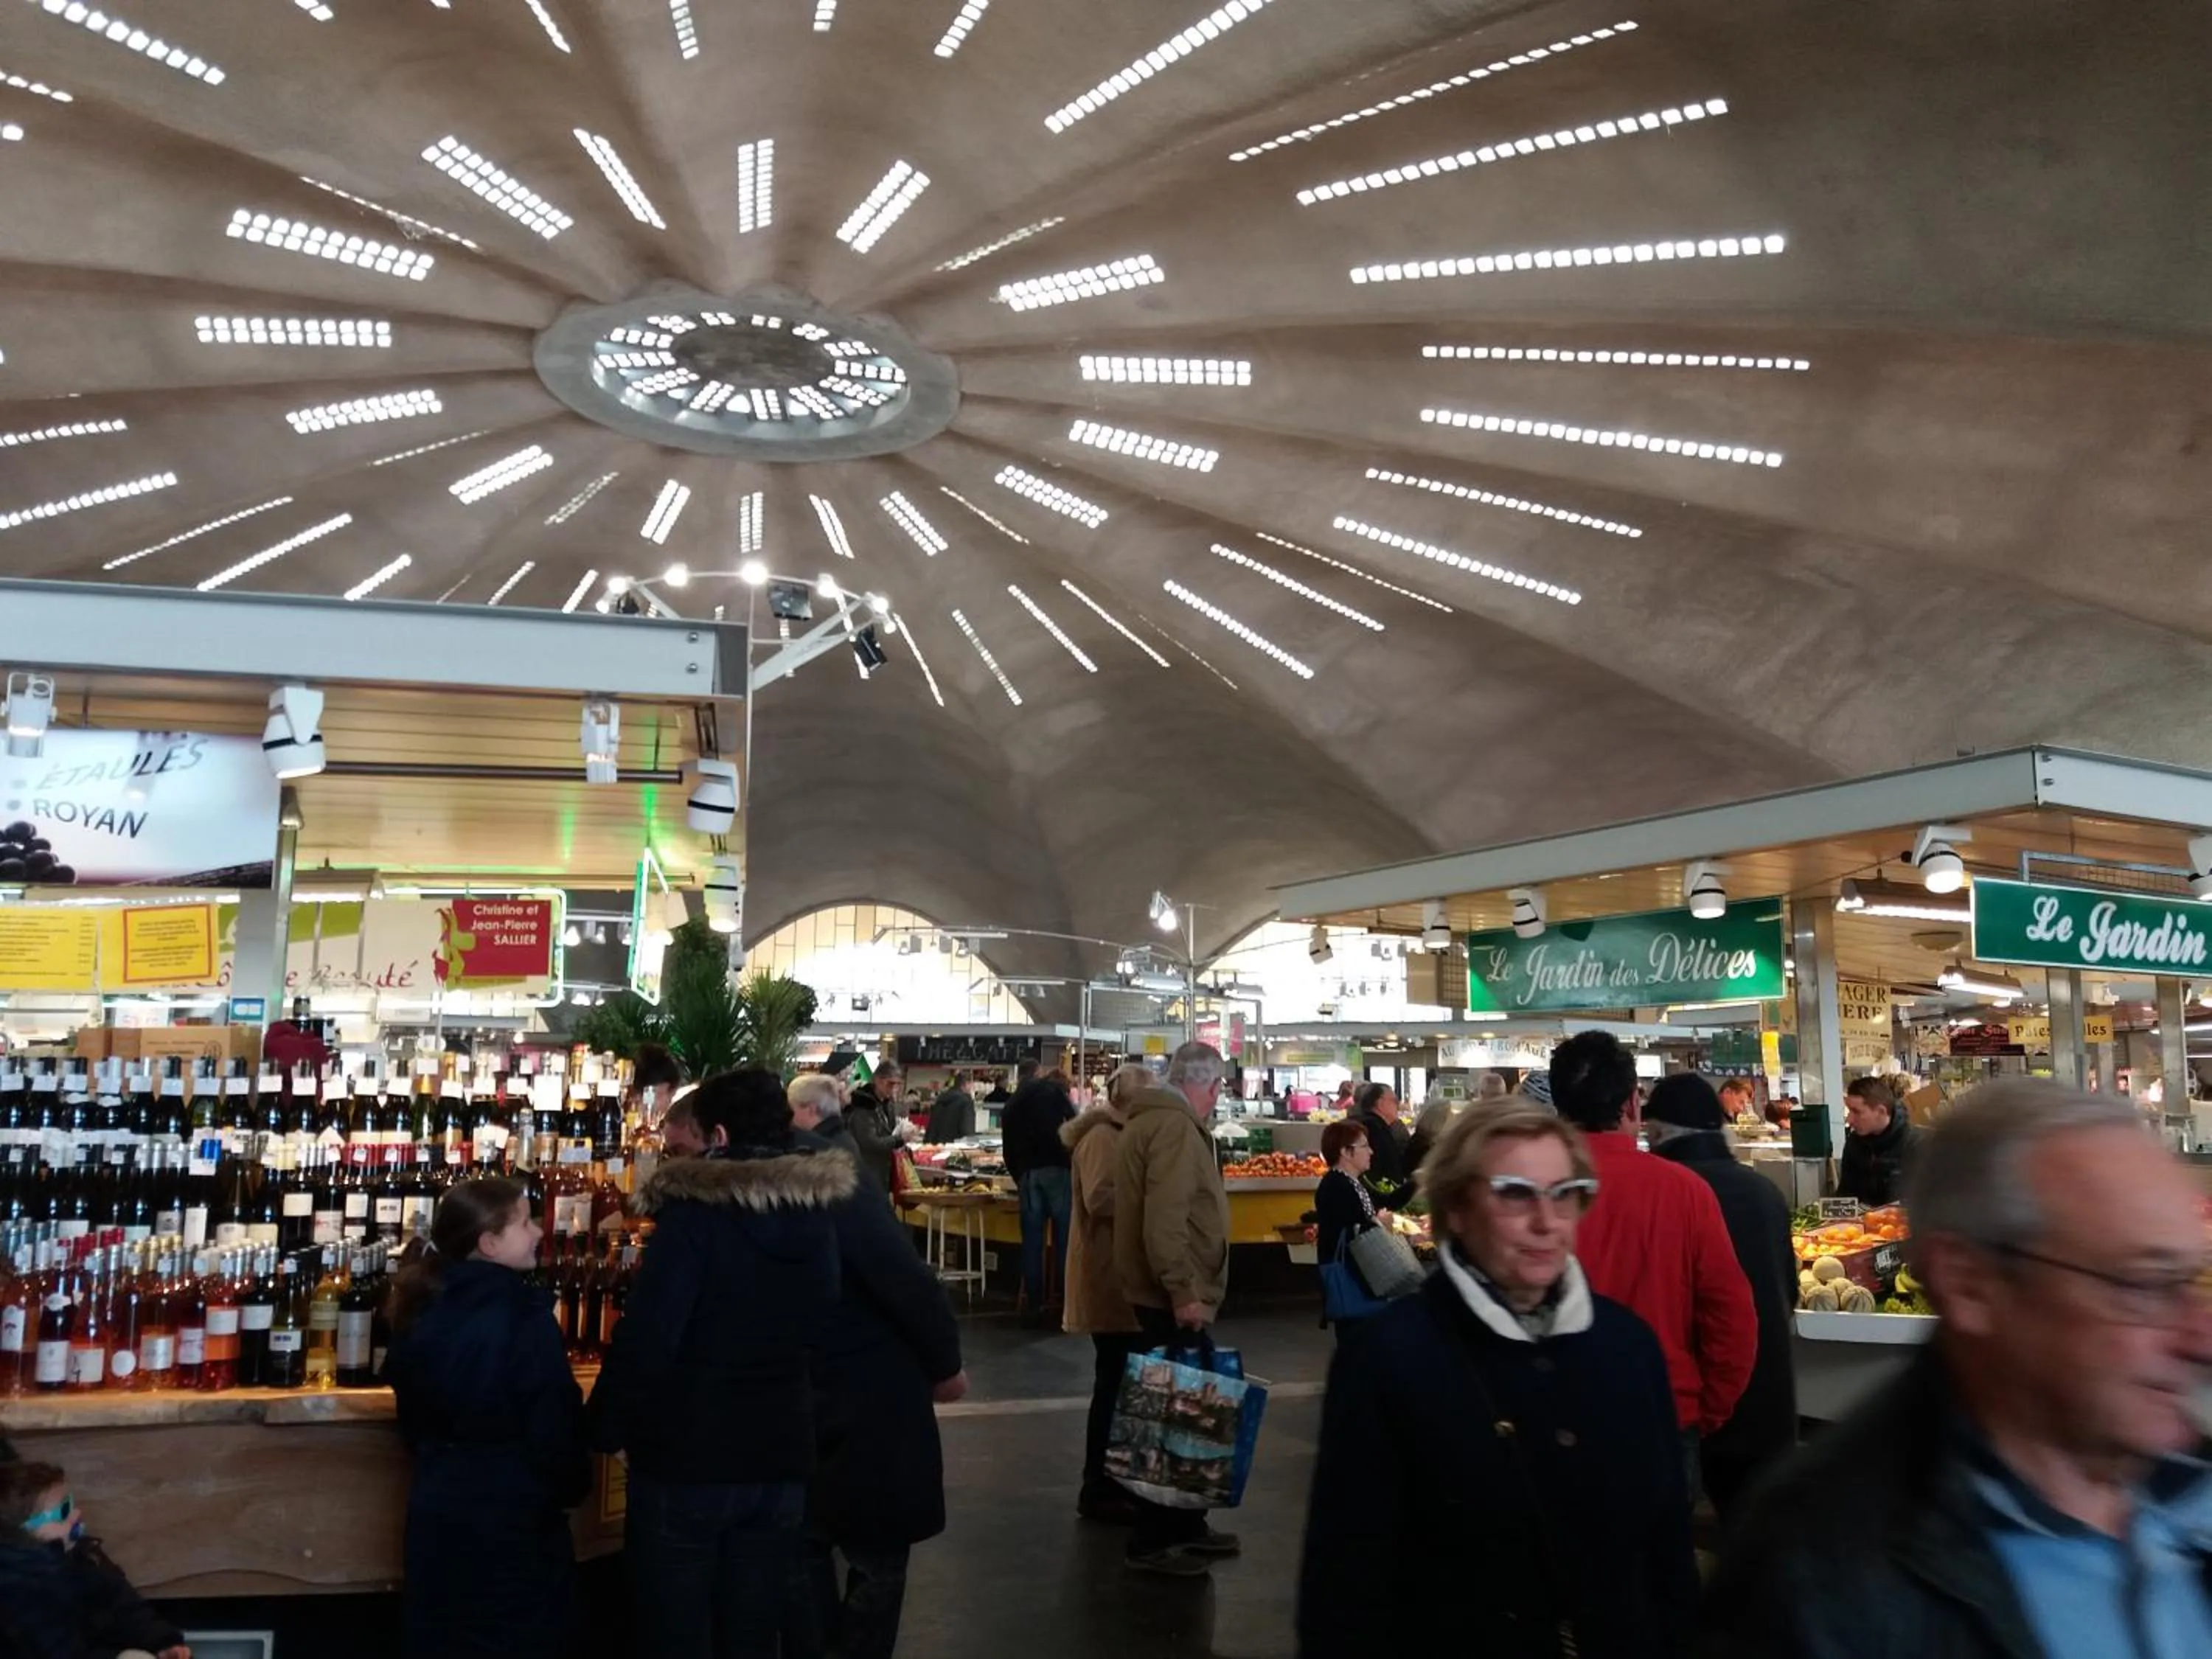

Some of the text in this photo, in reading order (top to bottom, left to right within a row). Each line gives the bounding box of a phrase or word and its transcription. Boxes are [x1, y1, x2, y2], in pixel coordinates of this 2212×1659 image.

[32, 799, 149, 838] ROYAN
[473, 904, 539, 916] Christine et
[470, 919, 538, 931] Jean-Pierre
[2026, 896, 2208, 964] Le Jardin
[493, 934, 537, 945] SALLIER
[1486, 932, 1757, 1006] Le Jardin des Délices
[1842, 983, 1887, 1004] AGER
